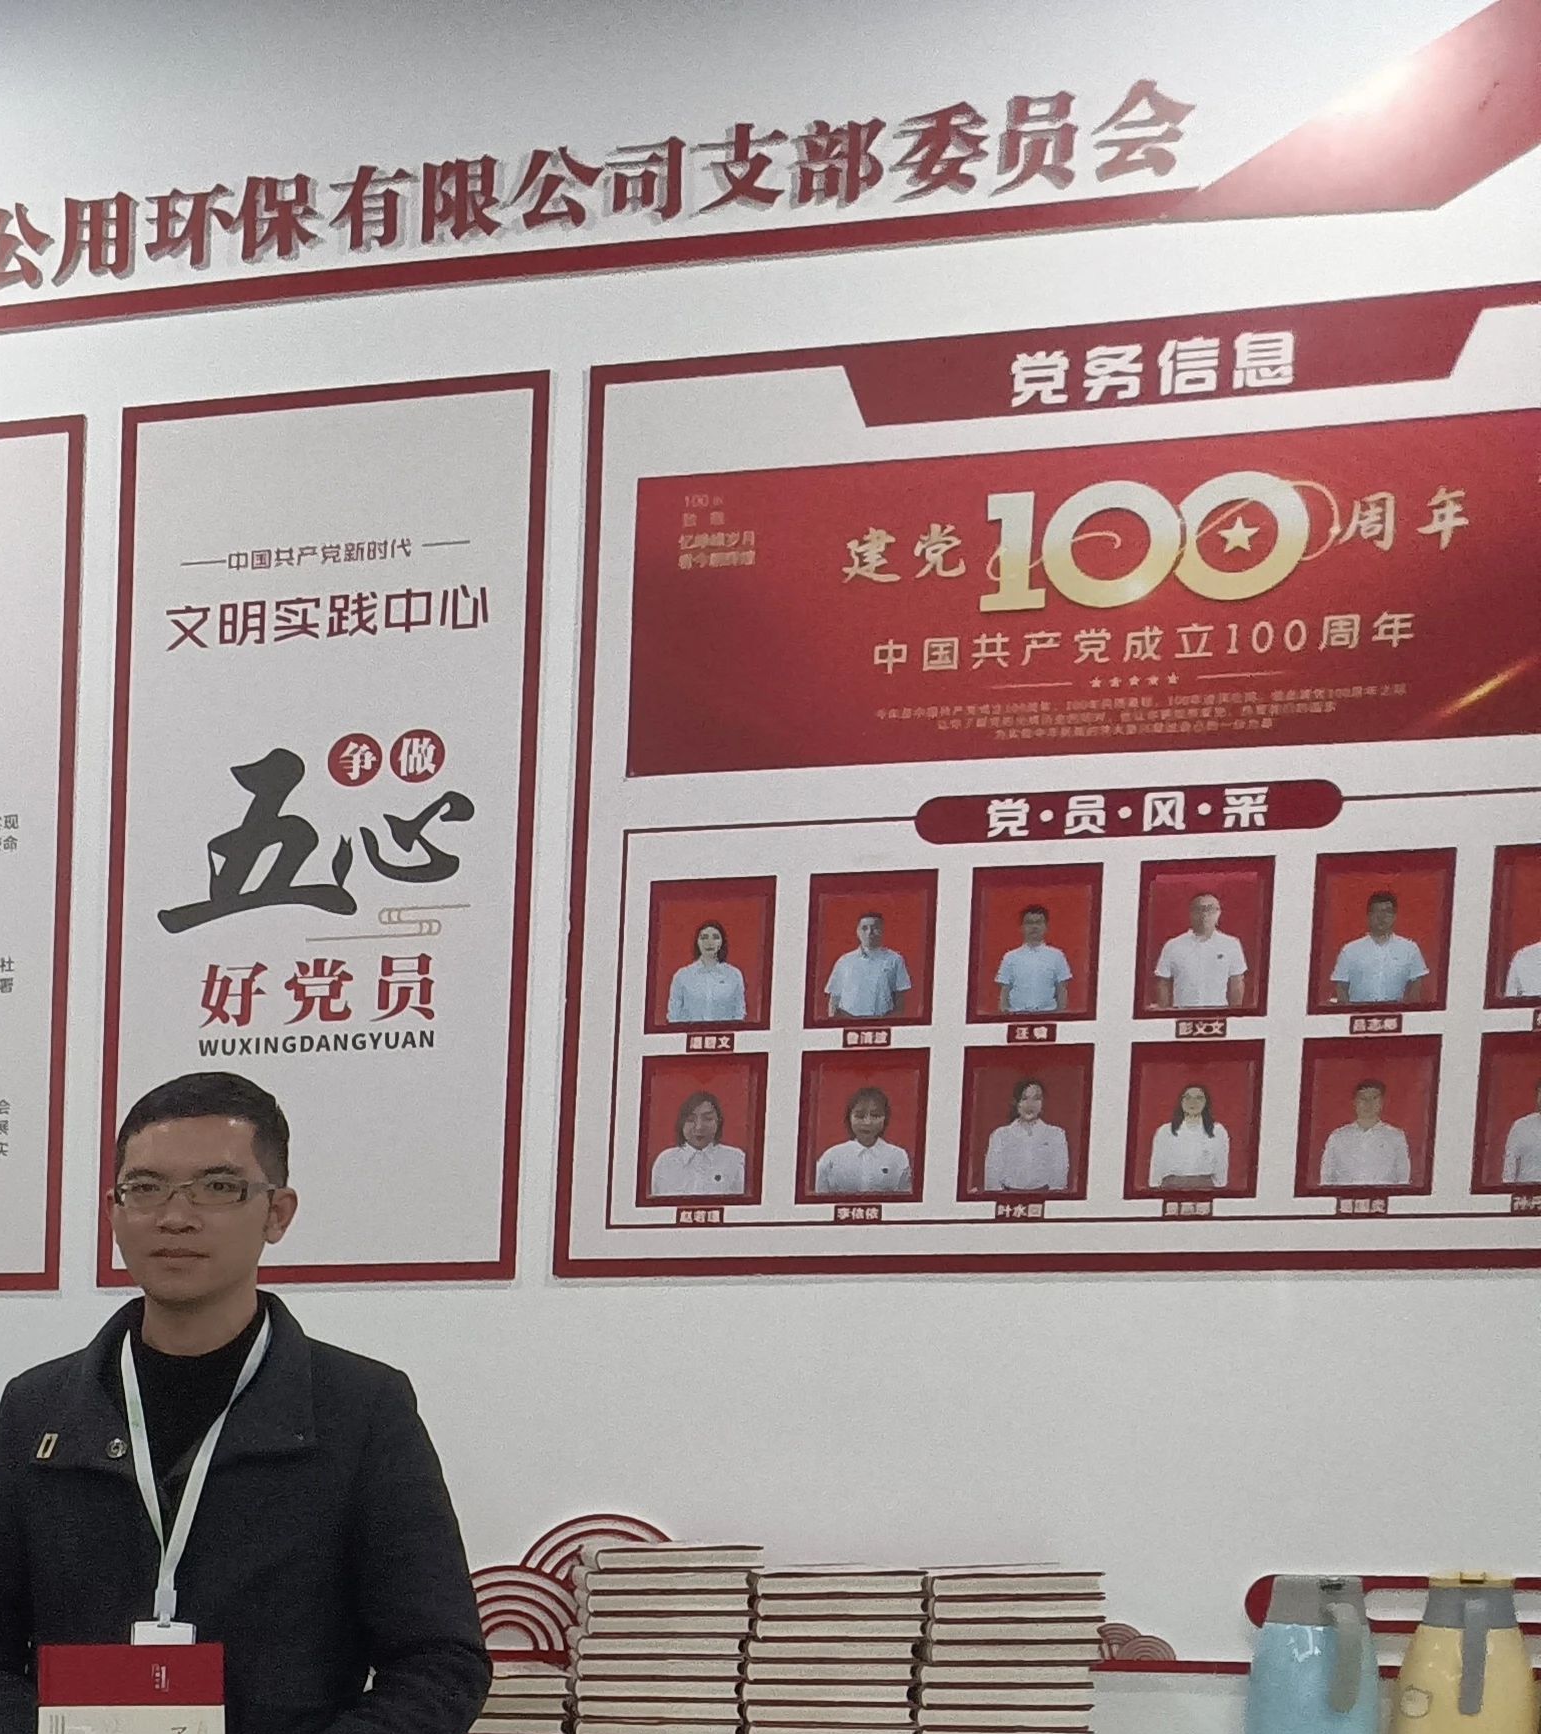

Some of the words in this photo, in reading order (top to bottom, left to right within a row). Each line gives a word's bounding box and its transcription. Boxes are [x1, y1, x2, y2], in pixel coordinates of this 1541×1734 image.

[1010, 329, 1296, 407] 党务信息
[227, 538, 412, 571] 中国共产党新时代
[166, 584, 488, 651] 文明实践中心
[873, 611, 1415, 675] 中国共产党成立100周年
[338, 734, 441, 780] 争做
[157, 748, 475, 934] 五心
[198, 952, 437, 1030] 好党员
[198, 1029, 436, 1057] WUXINGDANGYUAN
